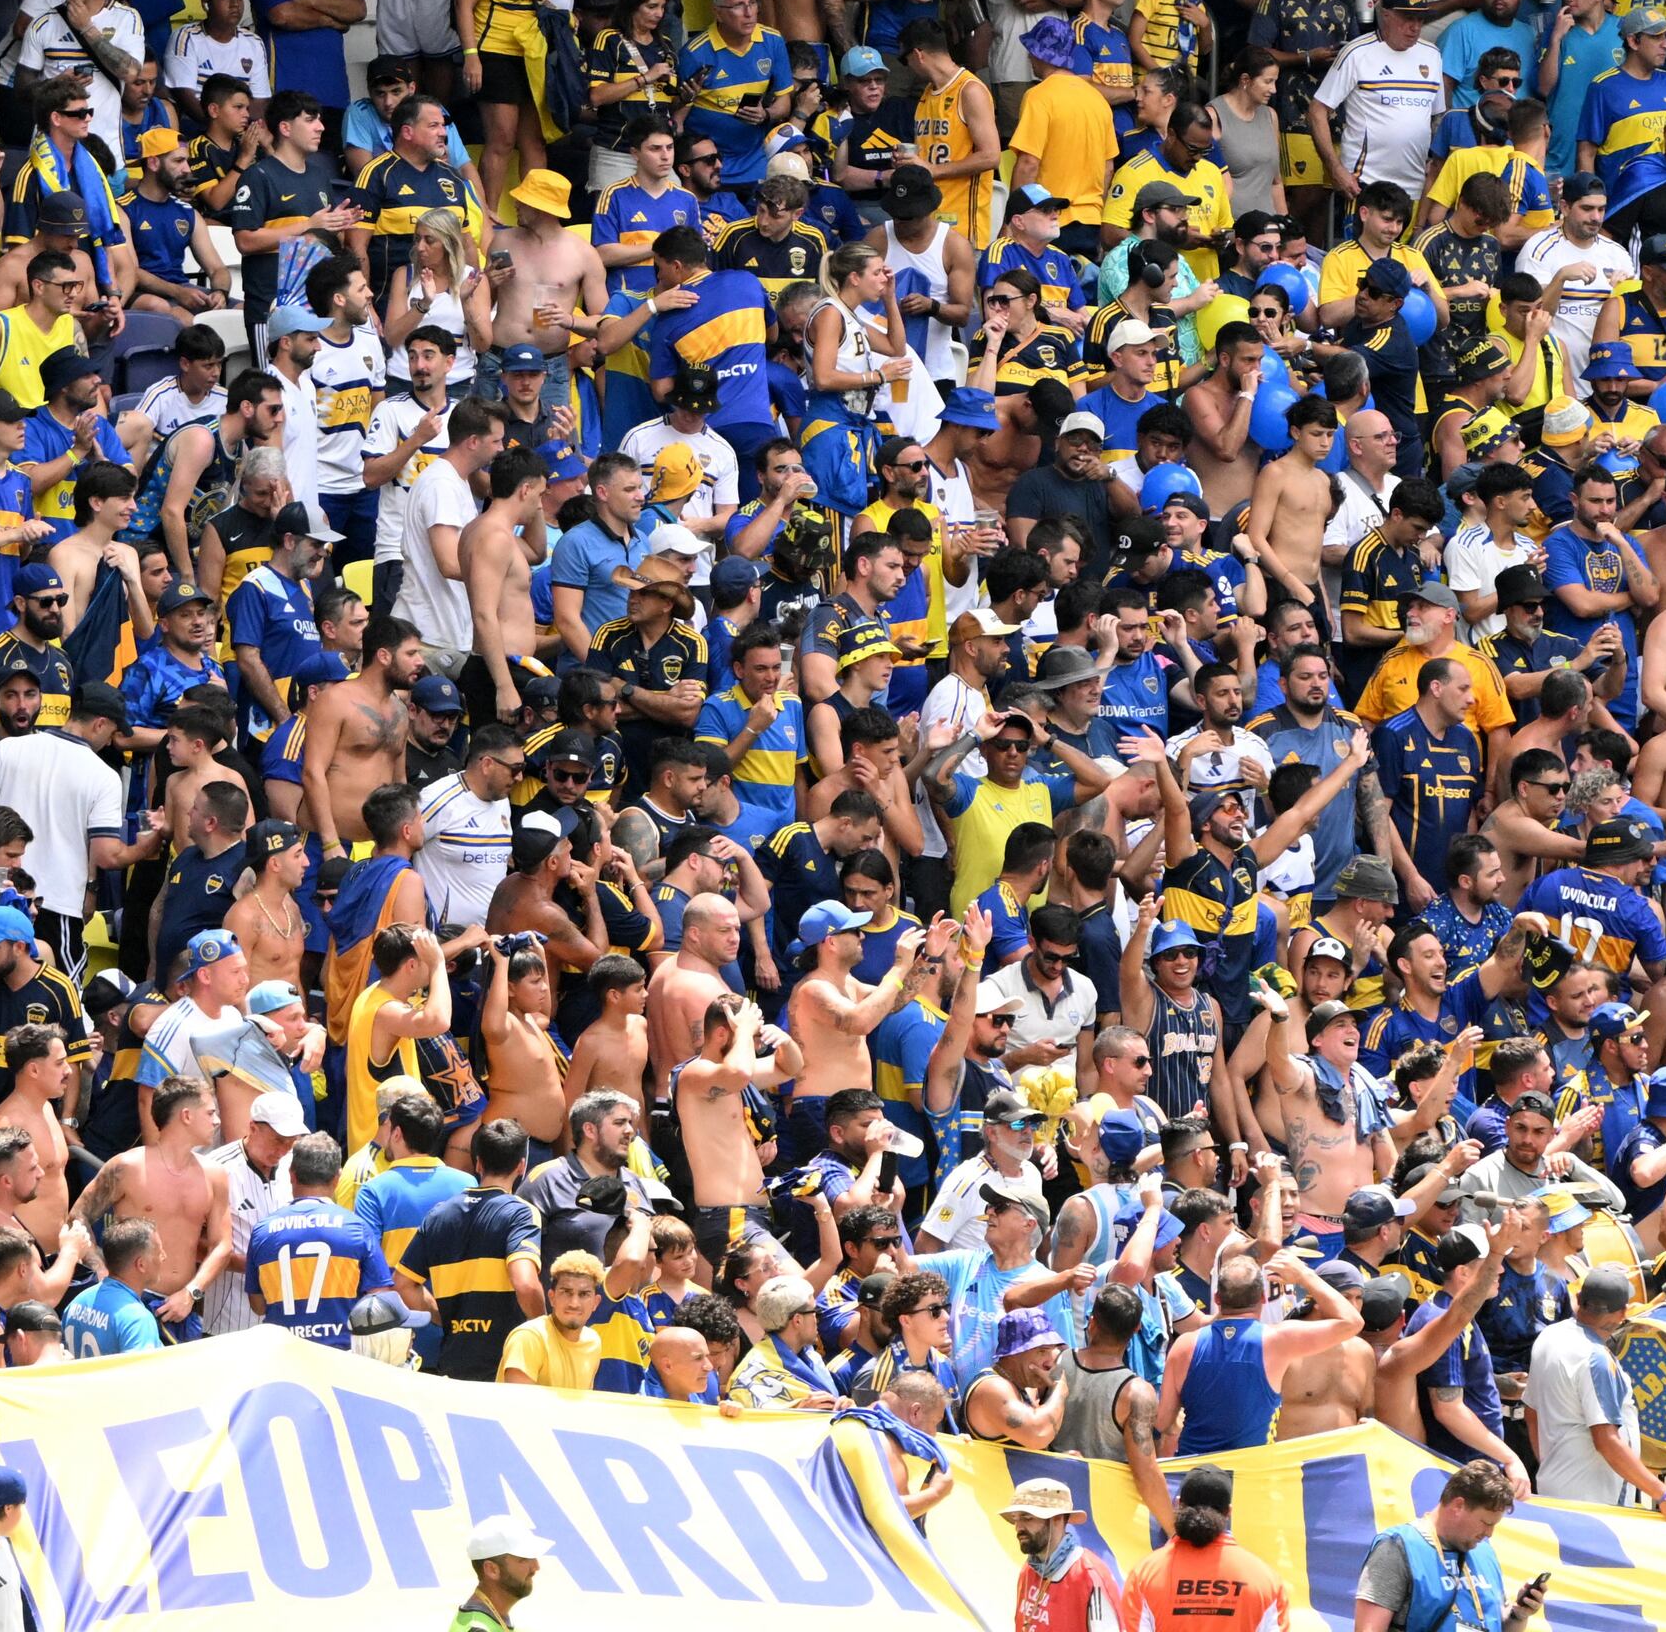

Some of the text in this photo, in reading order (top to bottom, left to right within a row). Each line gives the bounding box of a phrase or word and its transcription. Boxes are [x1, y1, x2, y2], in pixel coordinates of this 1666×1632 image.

[1379, 94, 1433, 109] betsson
[1557, 302, 1600, 317] betss
[1096, 705, 1130, 719] BBVA
[265, 834, 284, 852] 12
[461, 849, 510, 865] betsso
[277, 1240, 333, 1317] 17
[1174, 1579, 1247, 1598] BEST
